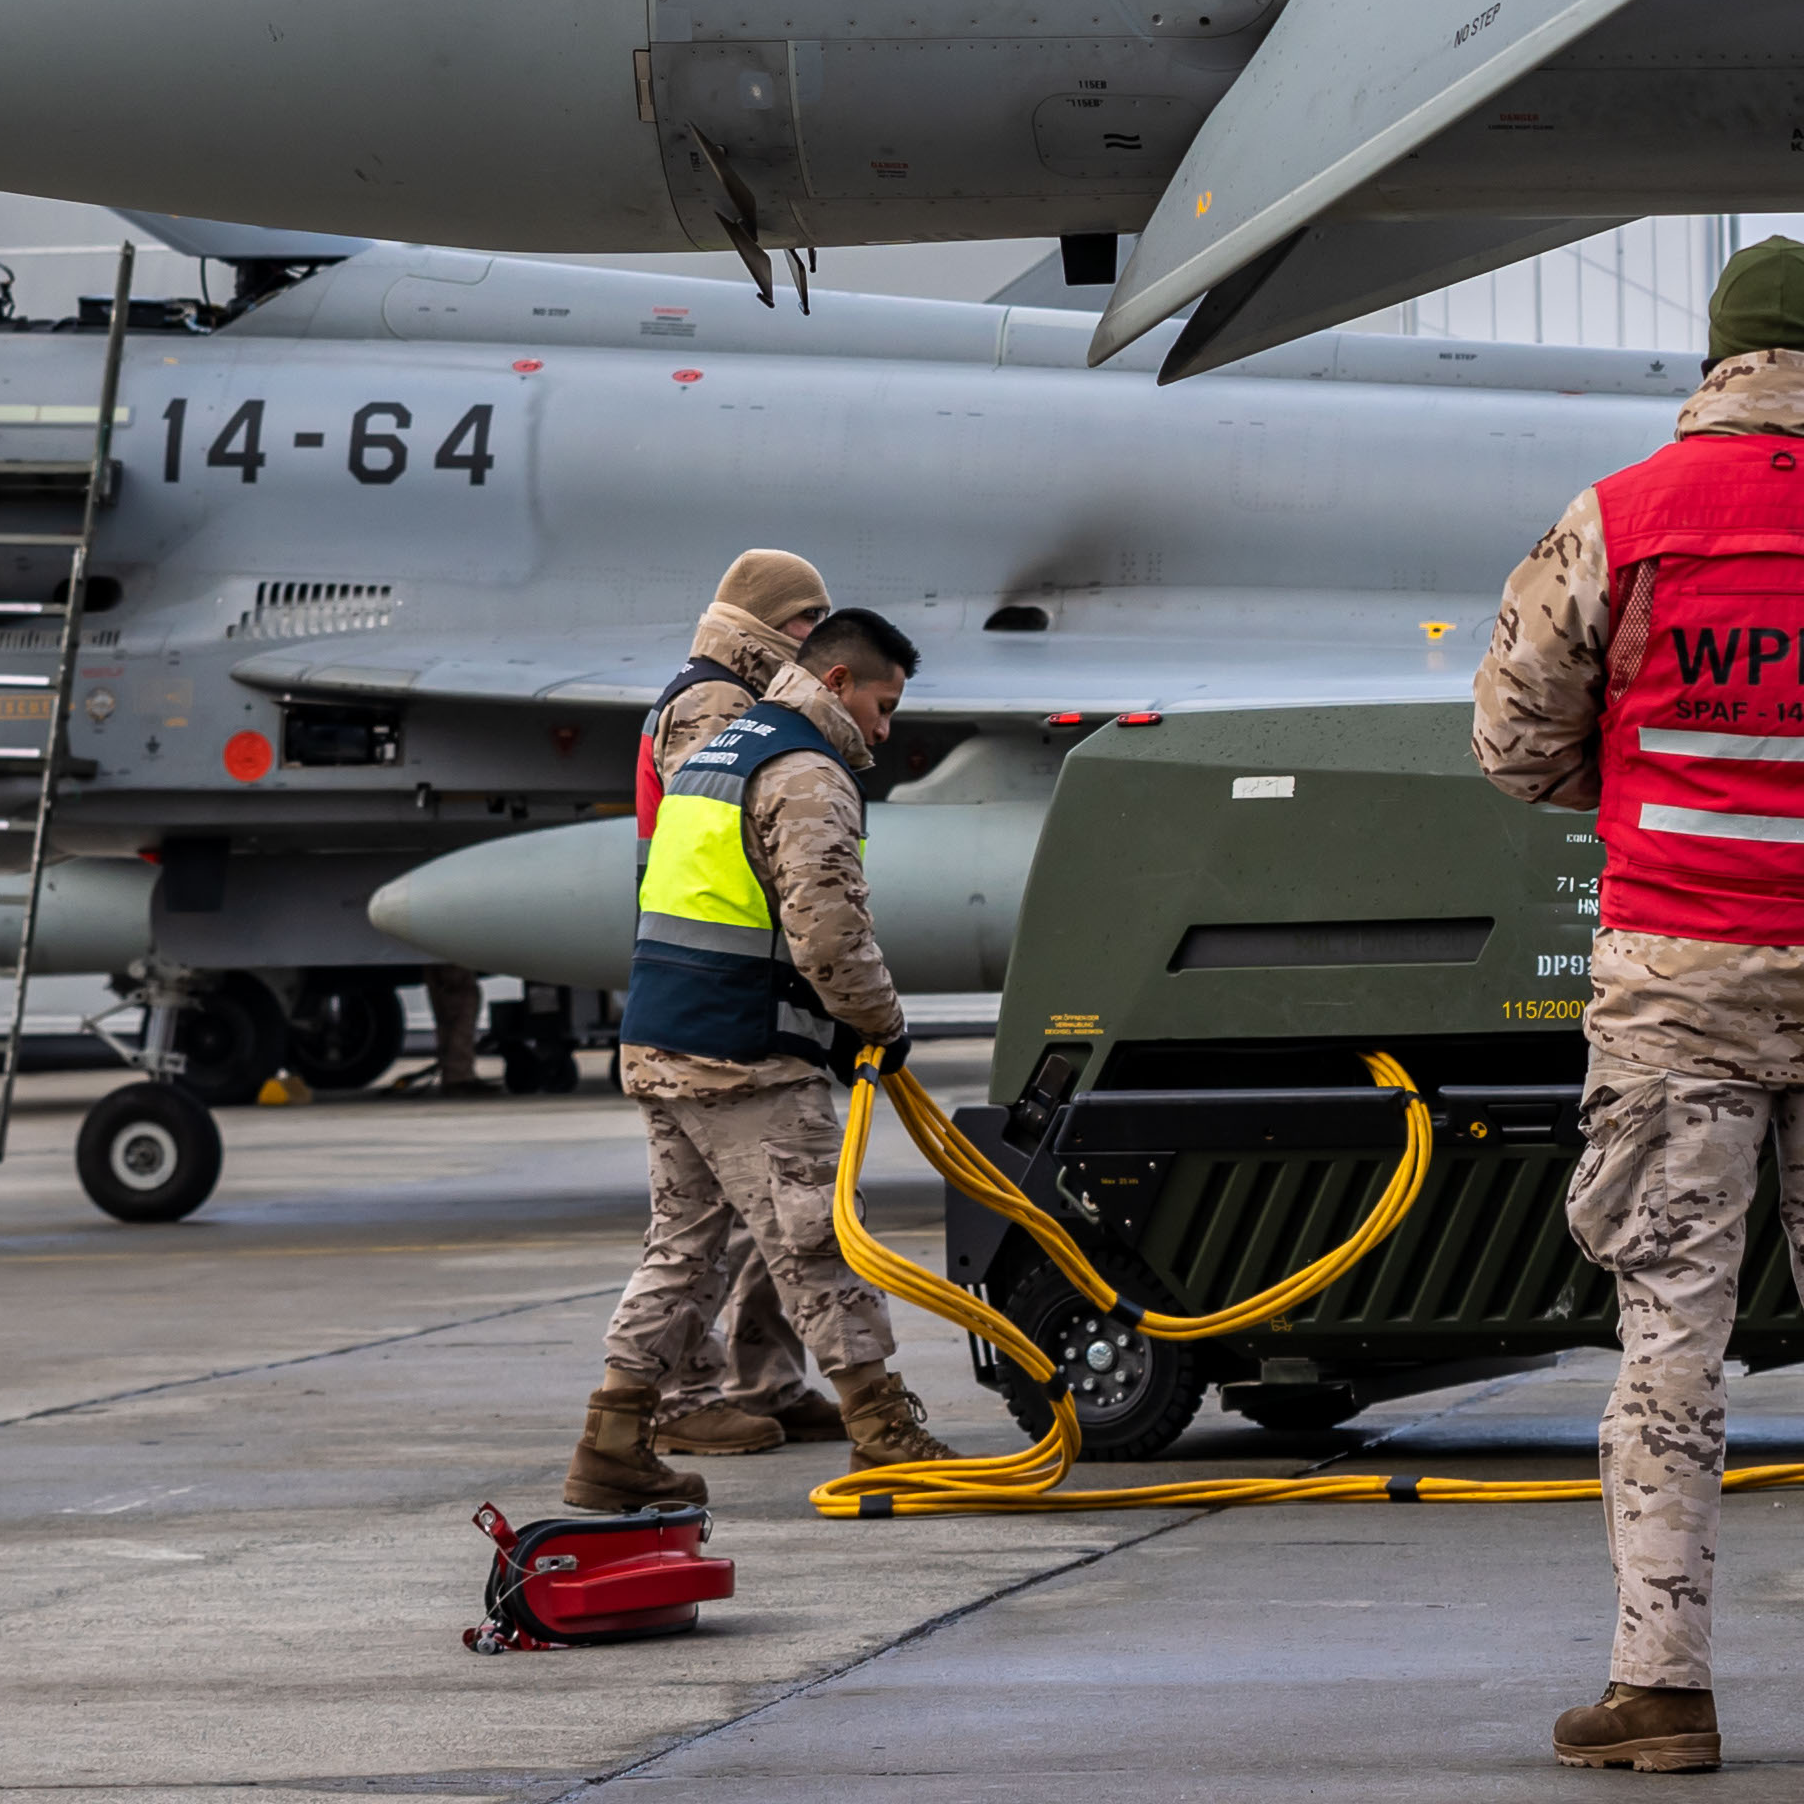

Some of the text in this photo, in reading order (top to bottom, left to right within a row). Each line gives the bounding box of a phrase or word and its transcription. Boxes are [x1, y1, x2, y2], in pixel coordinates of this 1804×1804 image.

[1453, 2, 1501, 48] NO STEP
[163, 398, 494, 485] 14-64
[1676, 699, 1748, 722] SPAF
[1567, 834, 1599, 843] EQUI
